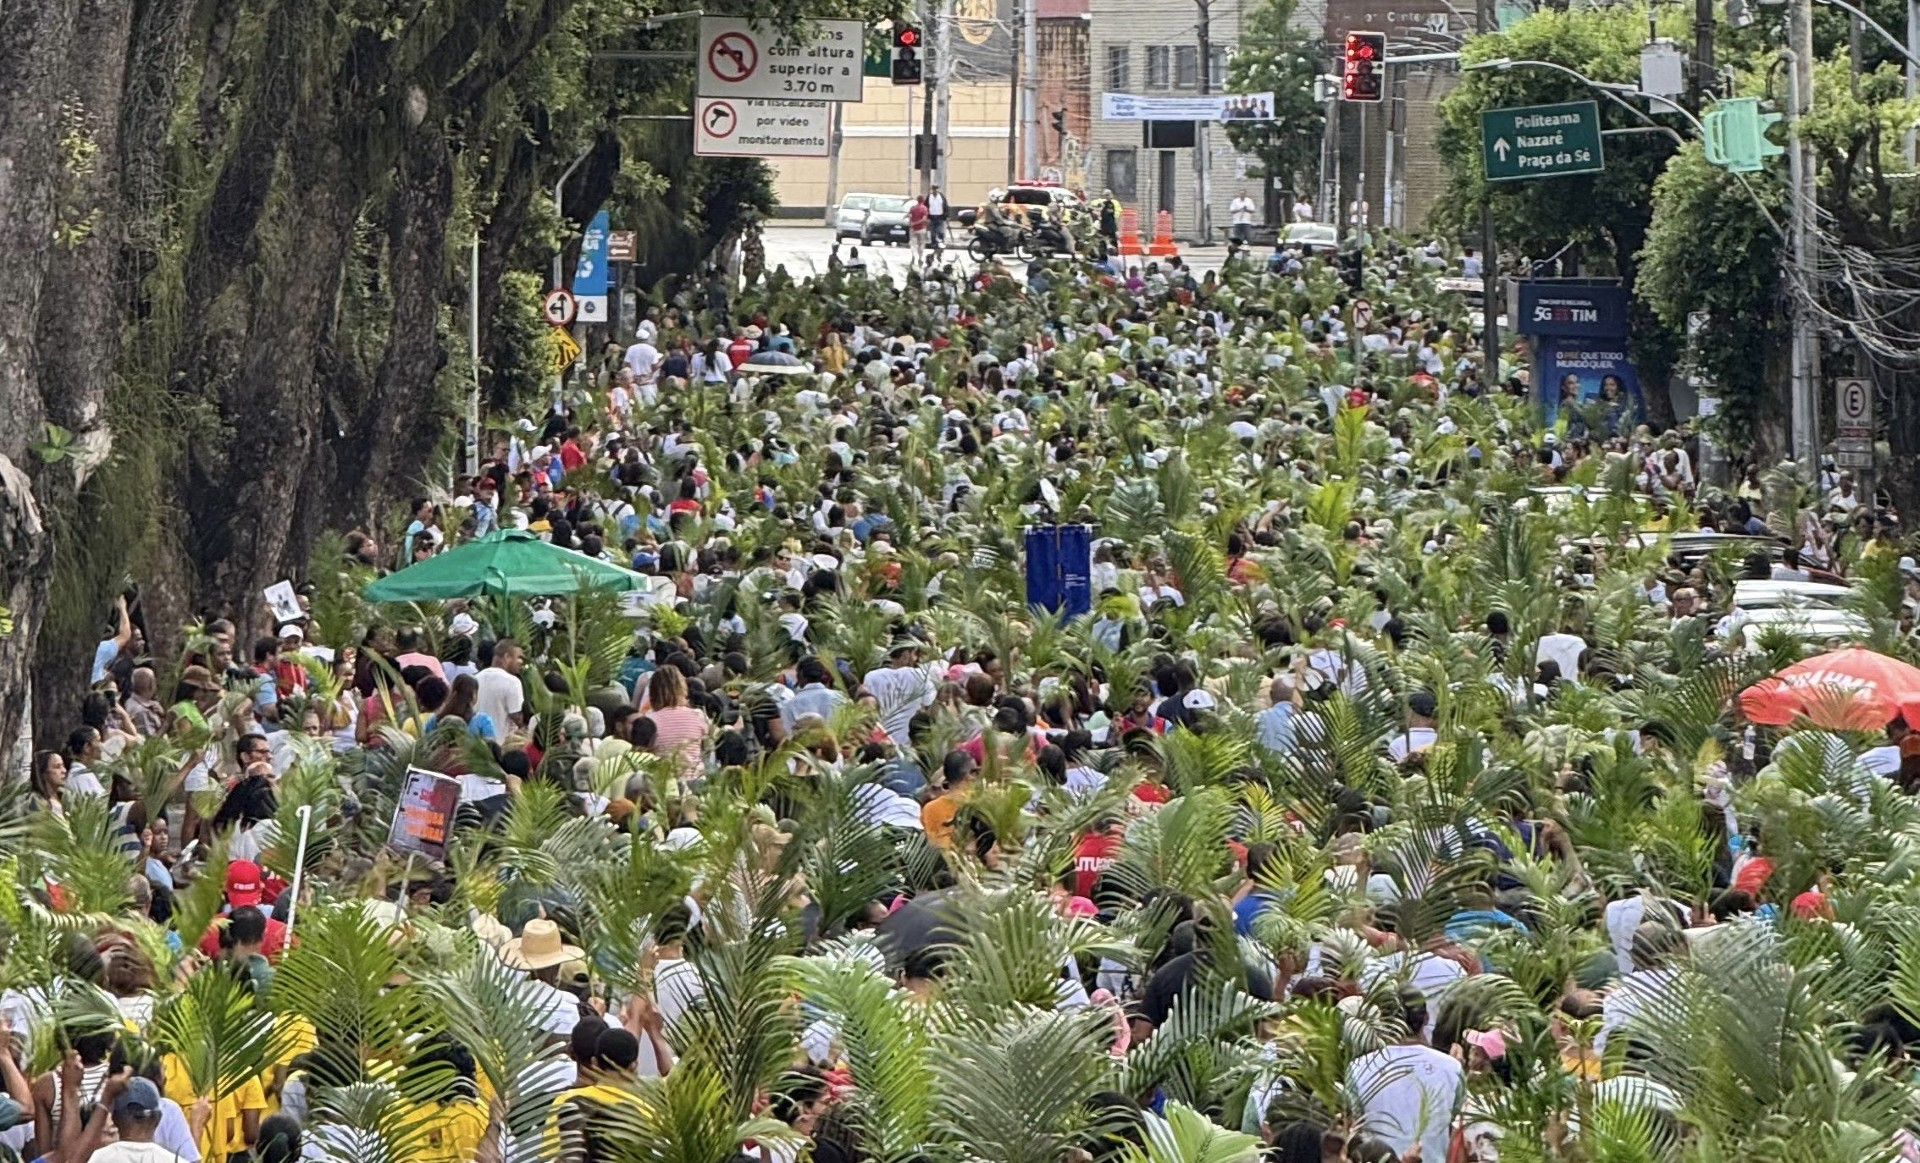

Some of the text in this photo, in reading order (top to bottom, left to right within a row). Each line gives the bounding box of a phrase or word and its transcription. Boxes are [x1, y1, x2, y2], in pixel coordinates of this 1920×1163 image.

[768, 46, 854, 58] com altura
[769, 63, 850, 76] superior a
[783, 80, 834, 93] 3.70 m
[756, 118, 775, 127] por
[1514, 113, 1581, 129] Politeama
[738, 135, 825, 147] monitoramento
[1516, 129, 1564, 148] Nazaré
[1518, 147, 1591, 170] Praça da Sé
[1532, 306, 1597, 322] 5G TIM
[1555, 351, 1564, 360] O
[1580, 351, 1599, 360] QUE
[1599, 351, 1624, 361] TODO
[1850, 390, 1859, 411] E
